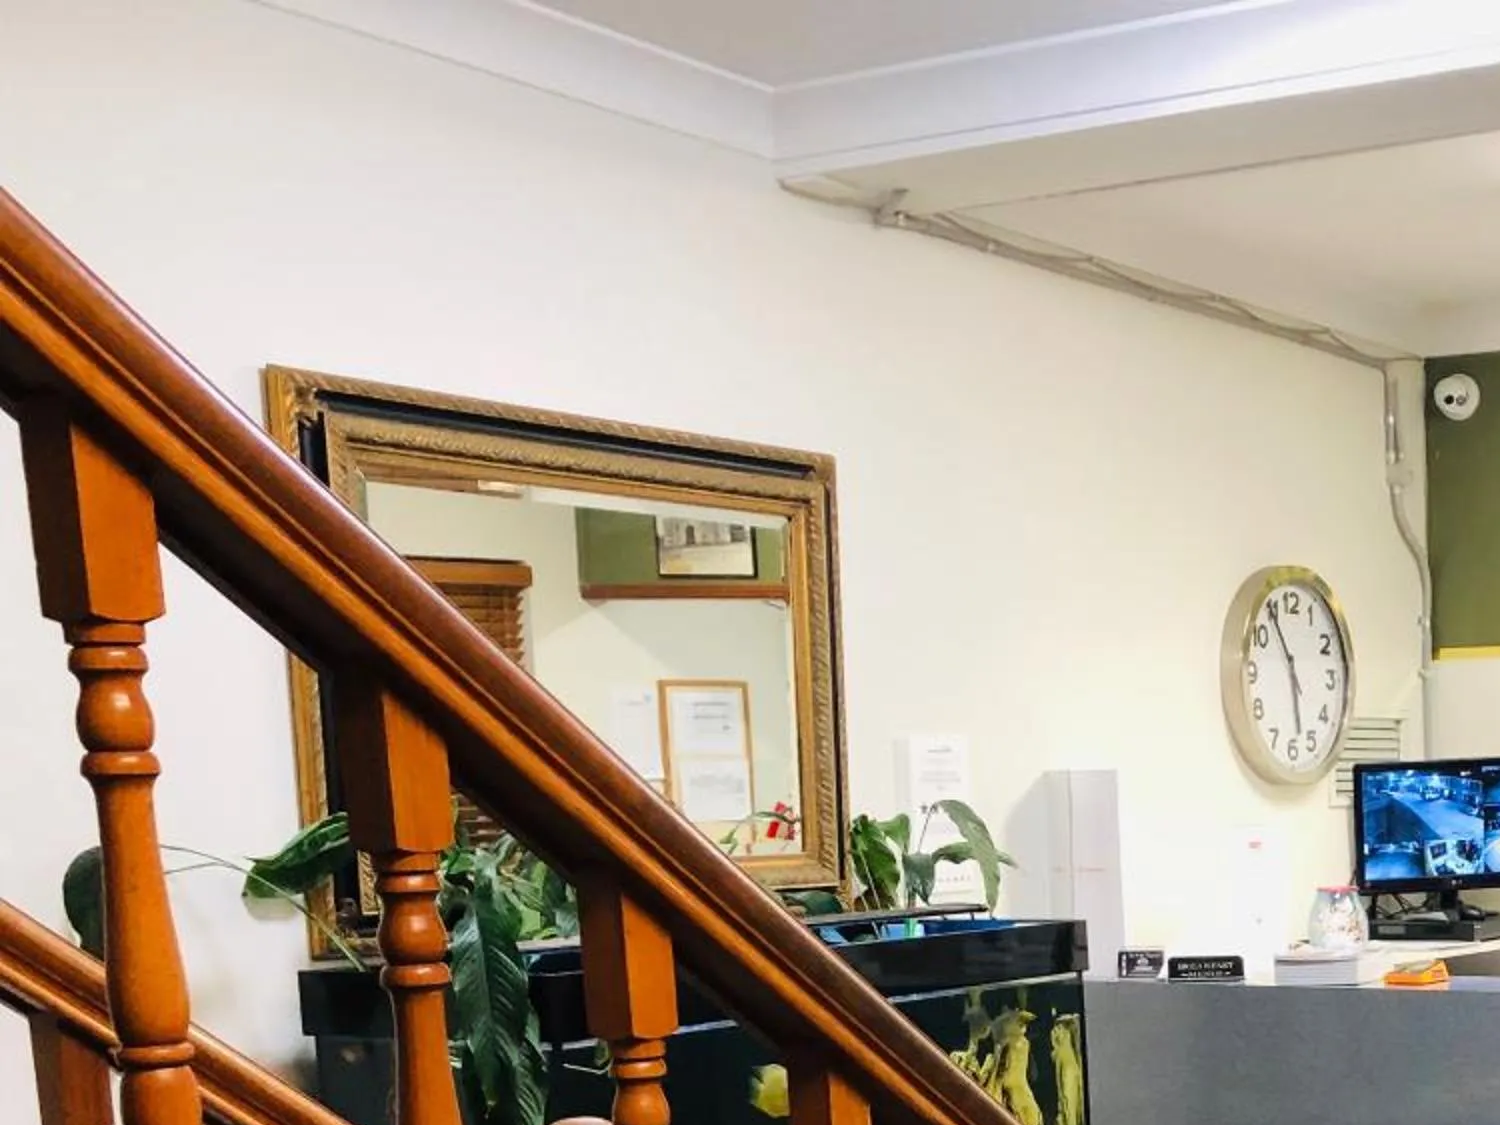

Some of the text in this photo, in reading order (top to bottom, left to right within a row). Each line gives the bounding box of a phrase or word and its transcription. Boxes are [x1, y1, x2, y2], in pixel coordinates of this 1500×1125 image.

[1283, 592, 1299, 614] 12
[1253, 625, 1269, 649] 10
[1319, 634, 1331, 655] 2
[1247, 661, 1257, 684] 9
[1325, 669, 1336, 690] 3
[1253, 698, 1264, 720] 8
[1318, 704, 1329, 723] 4
[1268, 728, 1279, 750] 7
[1287, 739, 1299, 760] 6
[1306, 731, 1317, 752] 5
